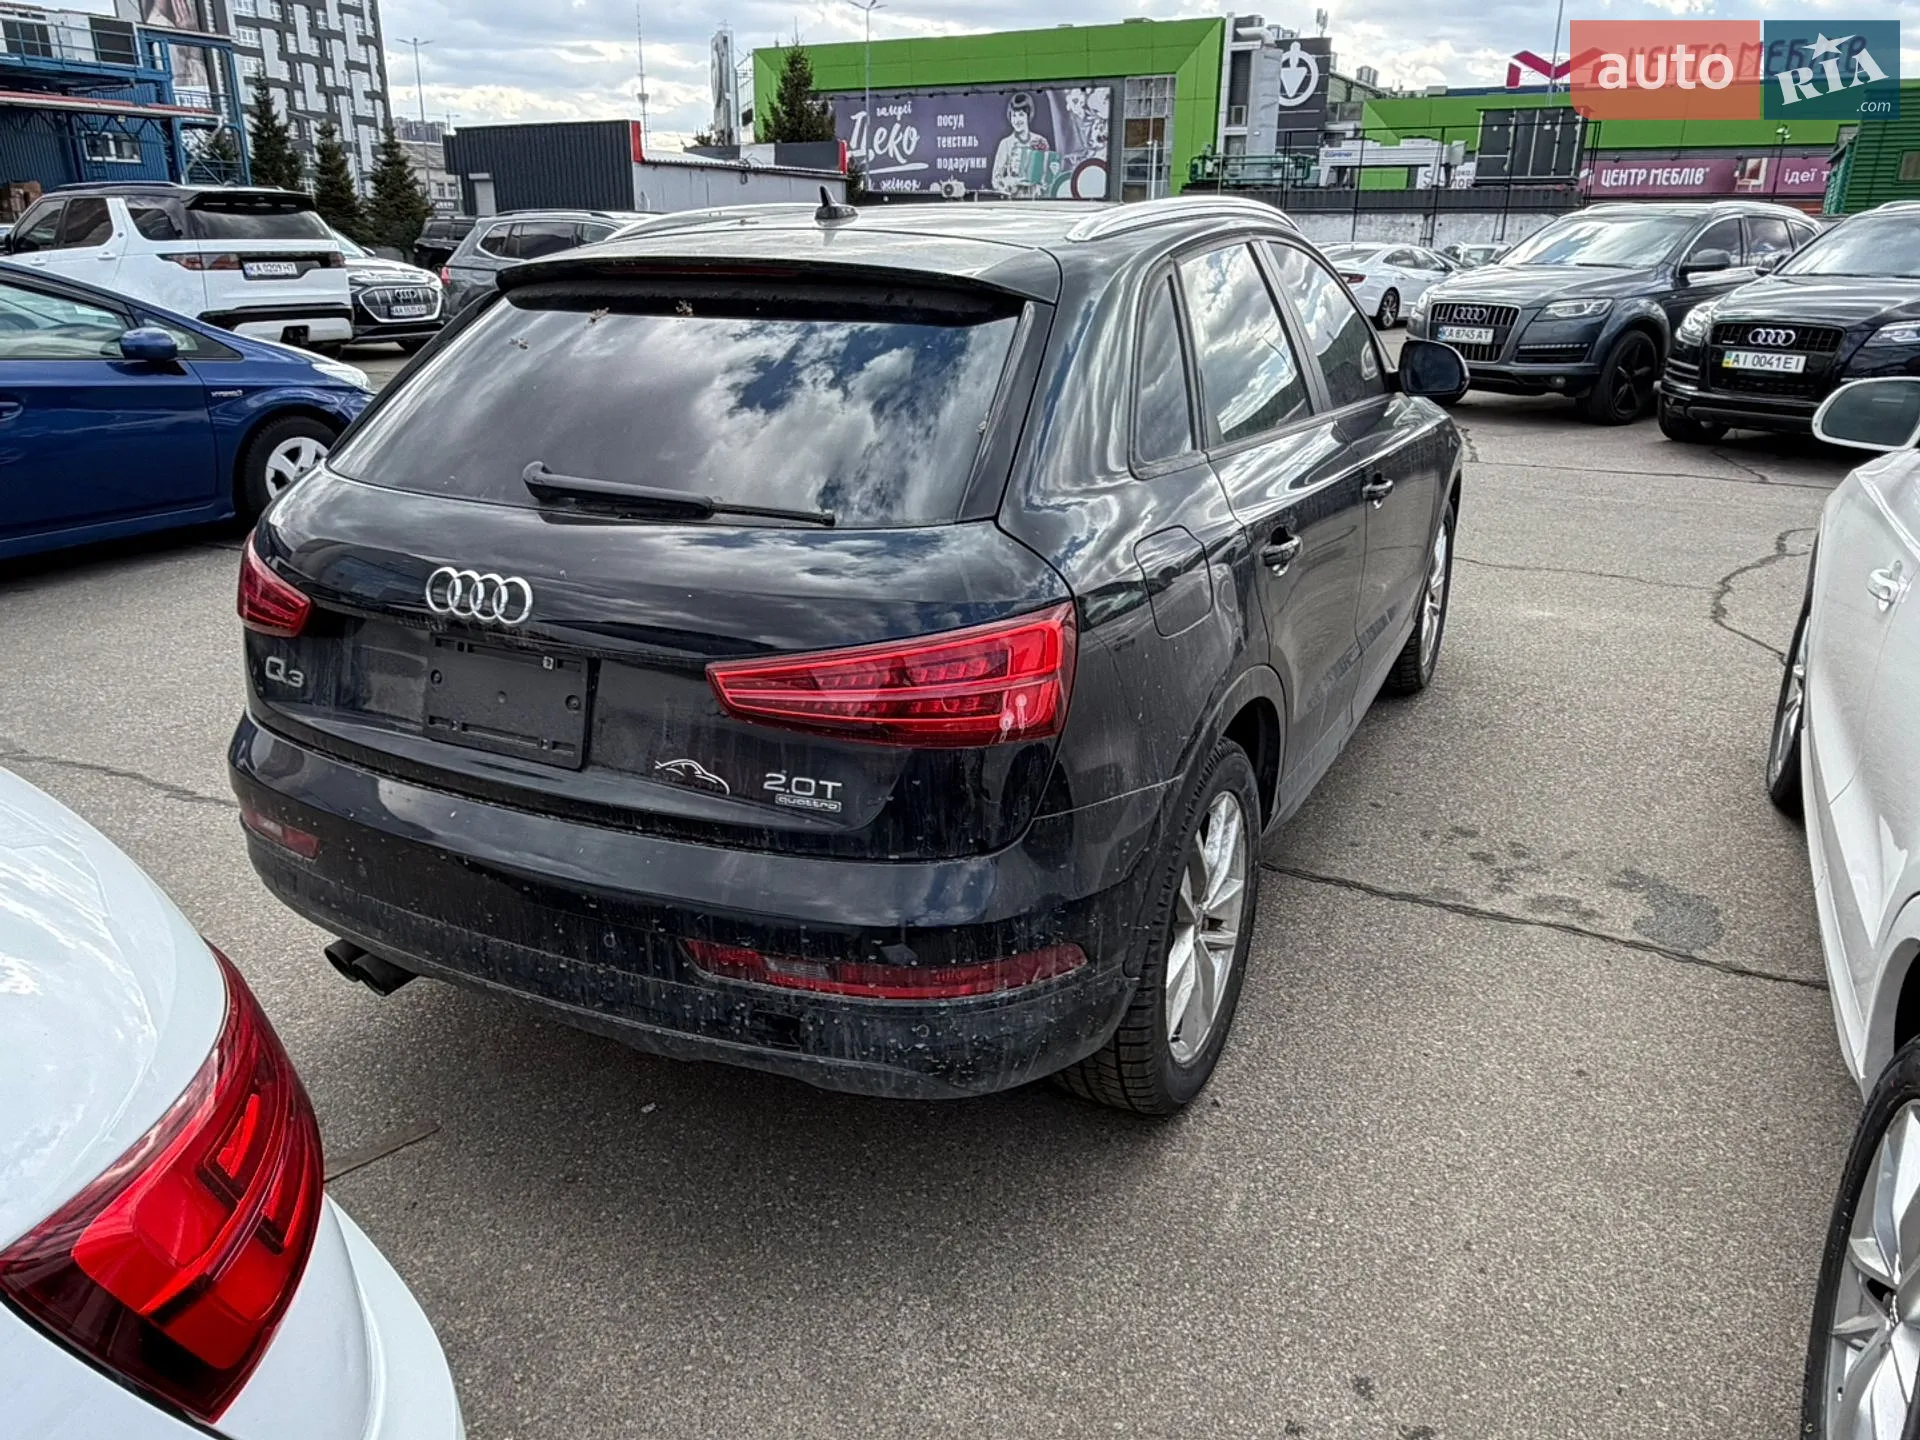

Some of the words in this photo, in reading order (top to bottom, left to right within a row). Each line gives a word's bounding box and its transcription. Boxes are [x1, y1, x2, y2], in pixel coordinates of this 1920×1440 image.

[936, 114, 965, 130] посуд
[847, 110, 920, 164] Деко
[936, 135, 979, 148] текстиль
[936, 157, 988, 172] подарунки
[1601, 168, 1648, 187] ЦЕНТР
[1784, 168, 1818, 184] ідеї
[1476, 330, 1490, 340] AT
[265, 656, 304, 688] Q3
[763, 773, 842, 799] 2.0T
[777, 795, 840, 812] quattro
